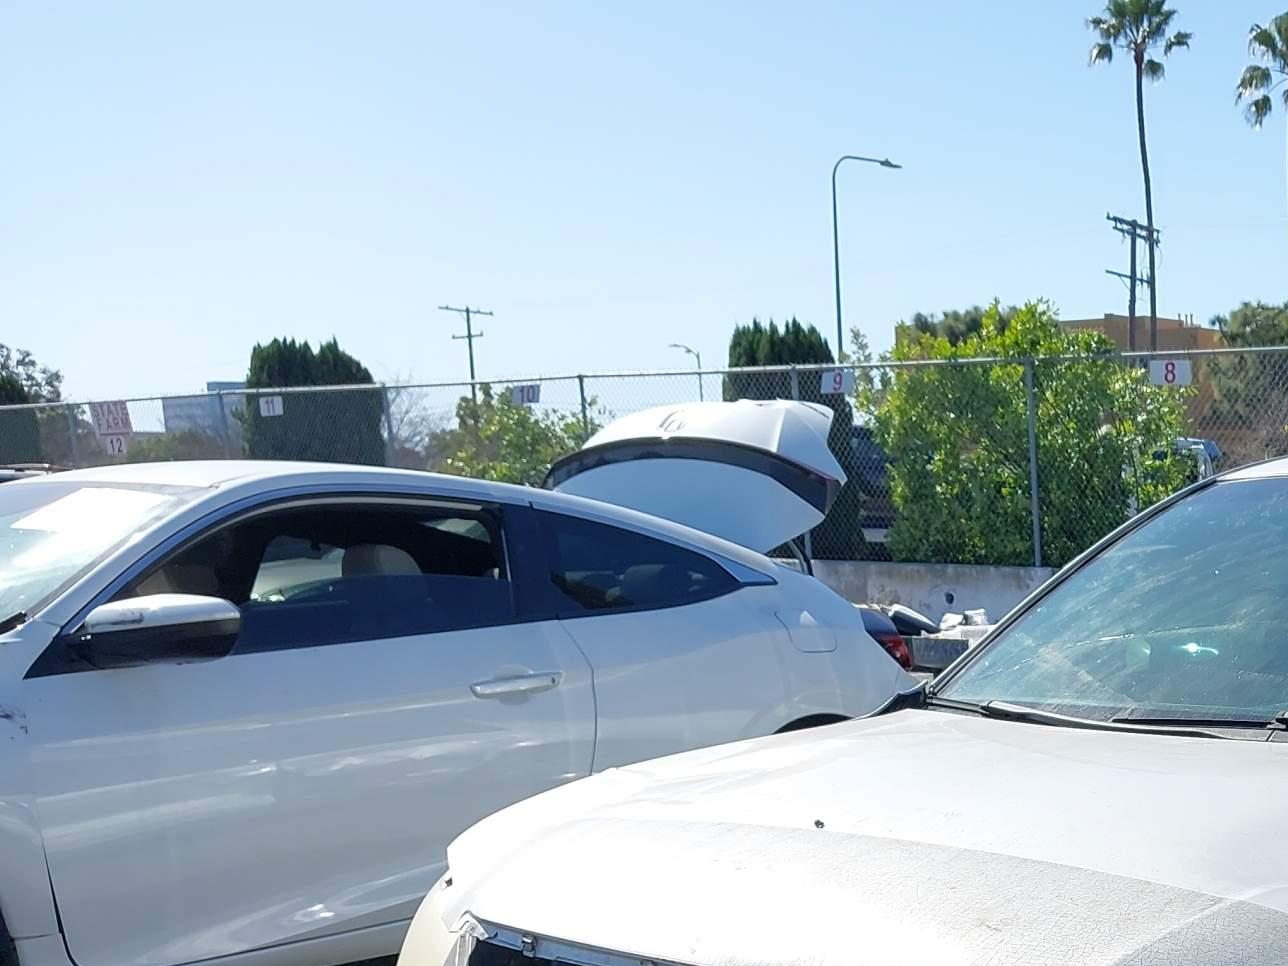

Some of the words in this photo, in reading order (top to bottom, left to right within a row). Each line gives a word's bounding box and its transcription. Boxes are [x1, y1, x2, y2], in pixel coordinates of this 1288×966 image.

[832, 371, 843, 391] 9
[1164, 361, 1177, 384] 8
[519, 385, 537, 403] 10
[264, 398, 276, 415] 11
[97, 417, 131, 431] FARM
[110, 438, 123, 455] 12
